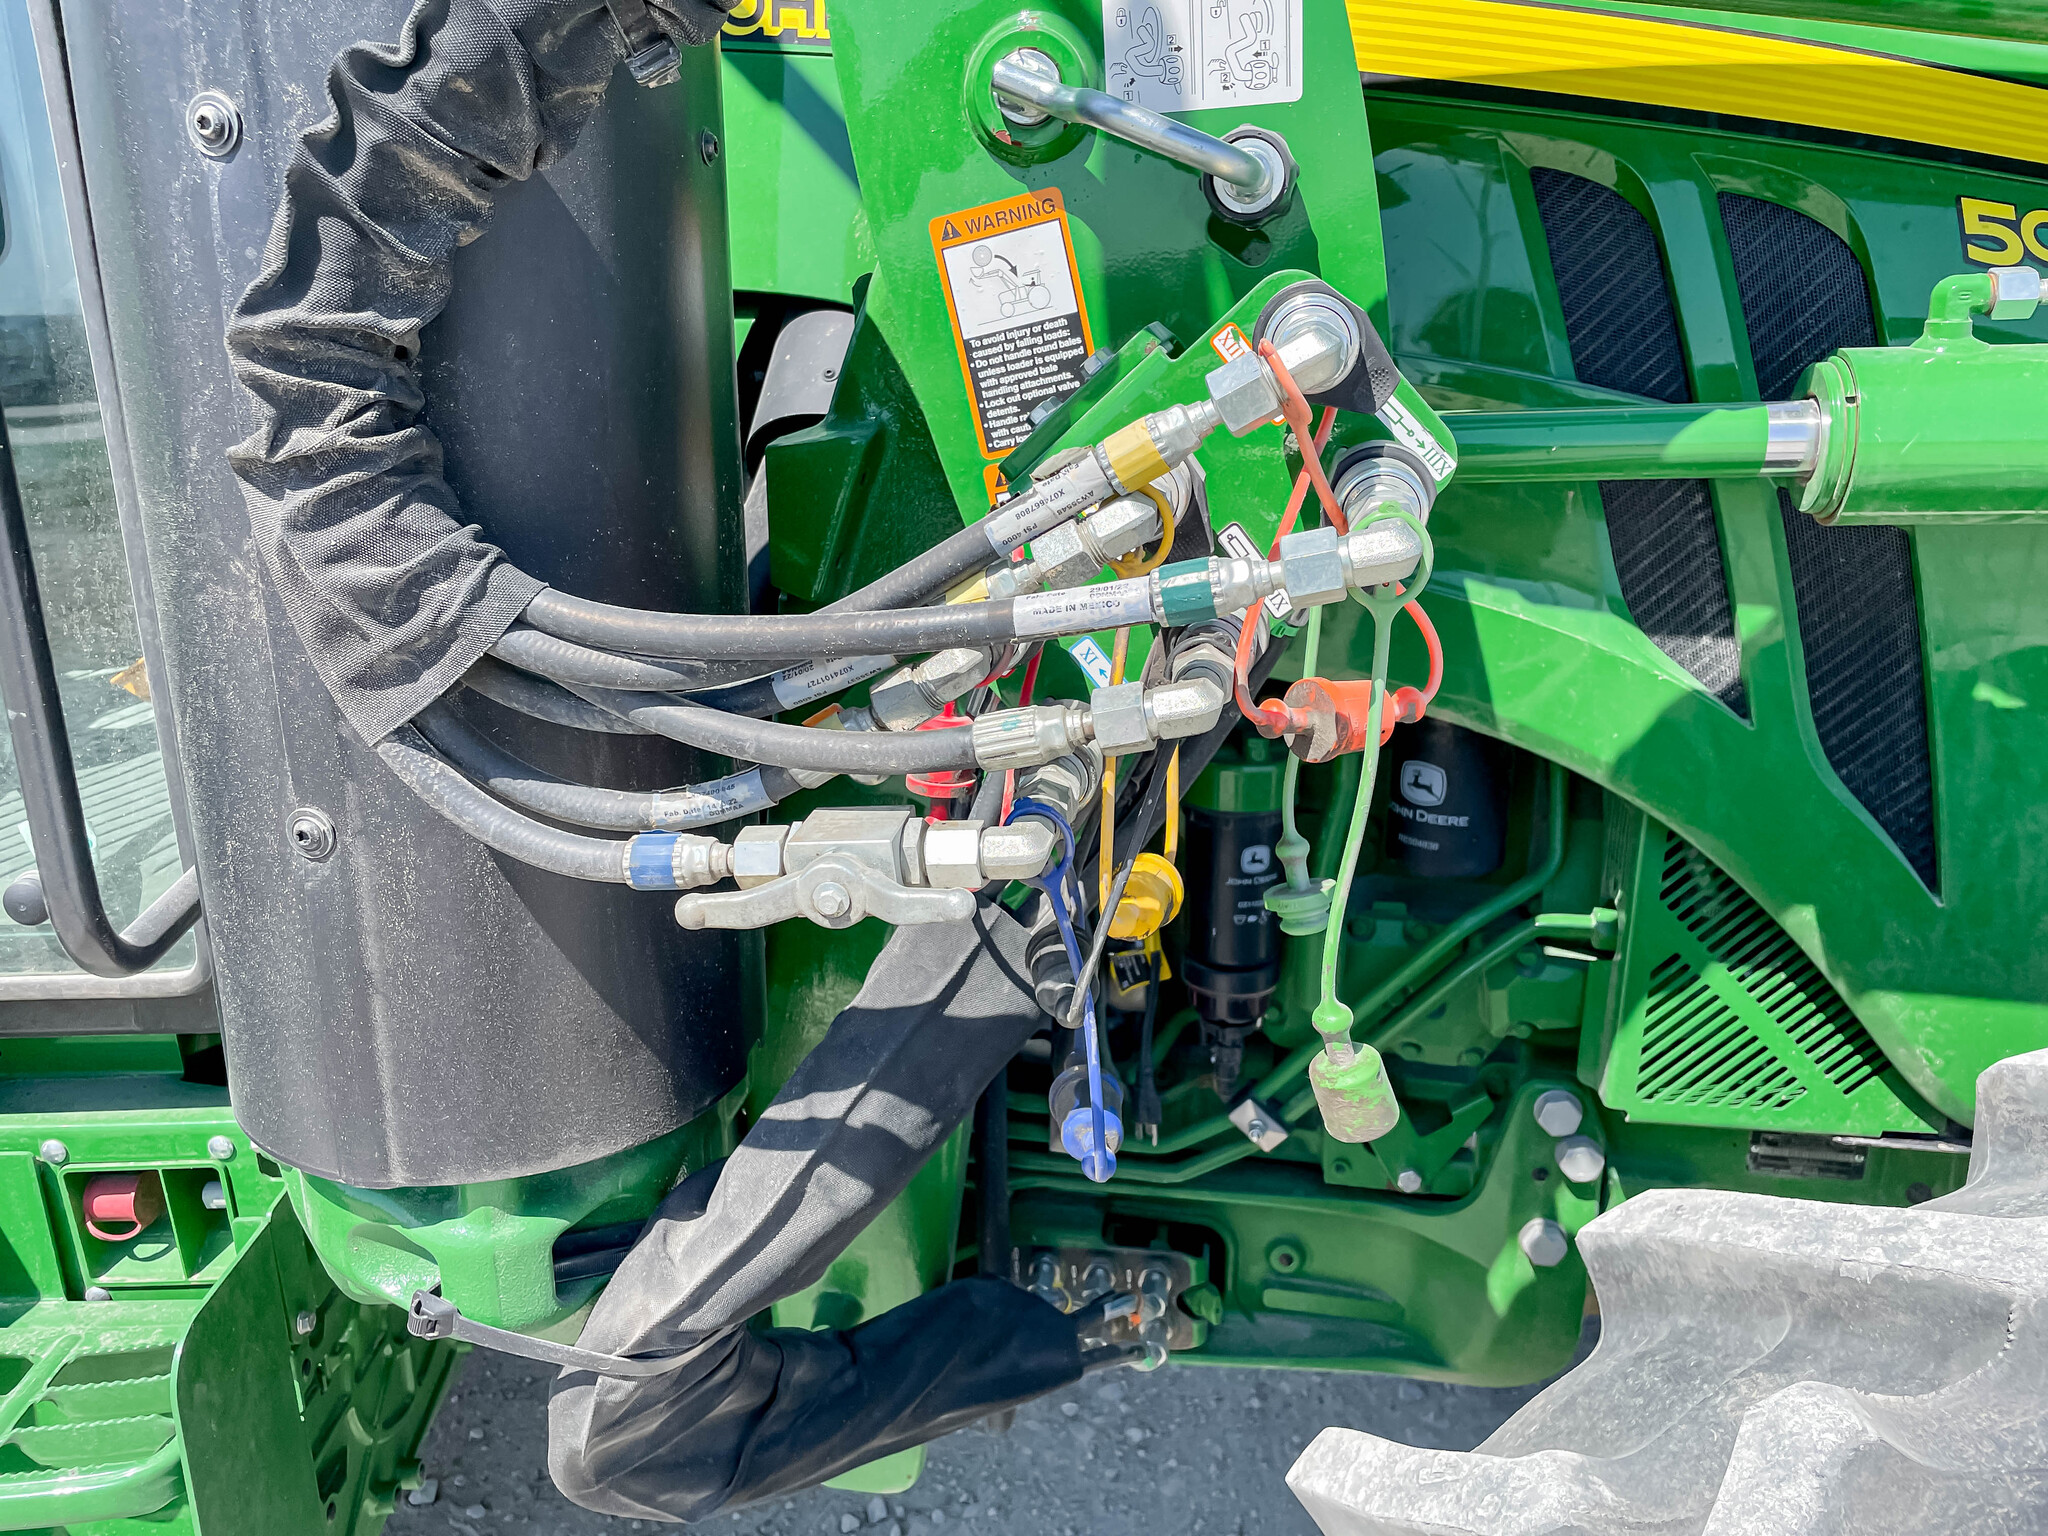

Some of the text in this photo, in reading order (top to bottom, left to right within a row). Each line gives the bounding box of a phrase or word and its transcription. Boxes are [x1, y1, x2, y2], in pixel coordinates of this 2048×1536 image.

[964, 198, 1056, 235] WARNING
[969, 318, 1068, 348] To avoid injury or death
[972, 328, 1070, 358] caused by falling loads:
[975, 336, 1082, 368] Do not handle round bales
[978, 346, 1084, 378] unless loader is equipped
[980, 364, 1058, 388] with approved bale
[982, 371, 1074, 398] handling attachments.
[984, 380, 1080, 408] Lock out optional valve
[986, 406, 1020, 418] detents.
[988, 416, 1018, 428] Handle
[990, 428, 1010, 438] with
[993, 438, 1016, 448] Carry
[1002, 523, 1038, 546] PSI 4000
[1032, 600, 1120, 616] MADE IN MEXICO
[782, 664, 815, 681] 20/01/22
[807, 665, 854, 688] X074101727
[1416, 809, 1470, 827] DEERE
